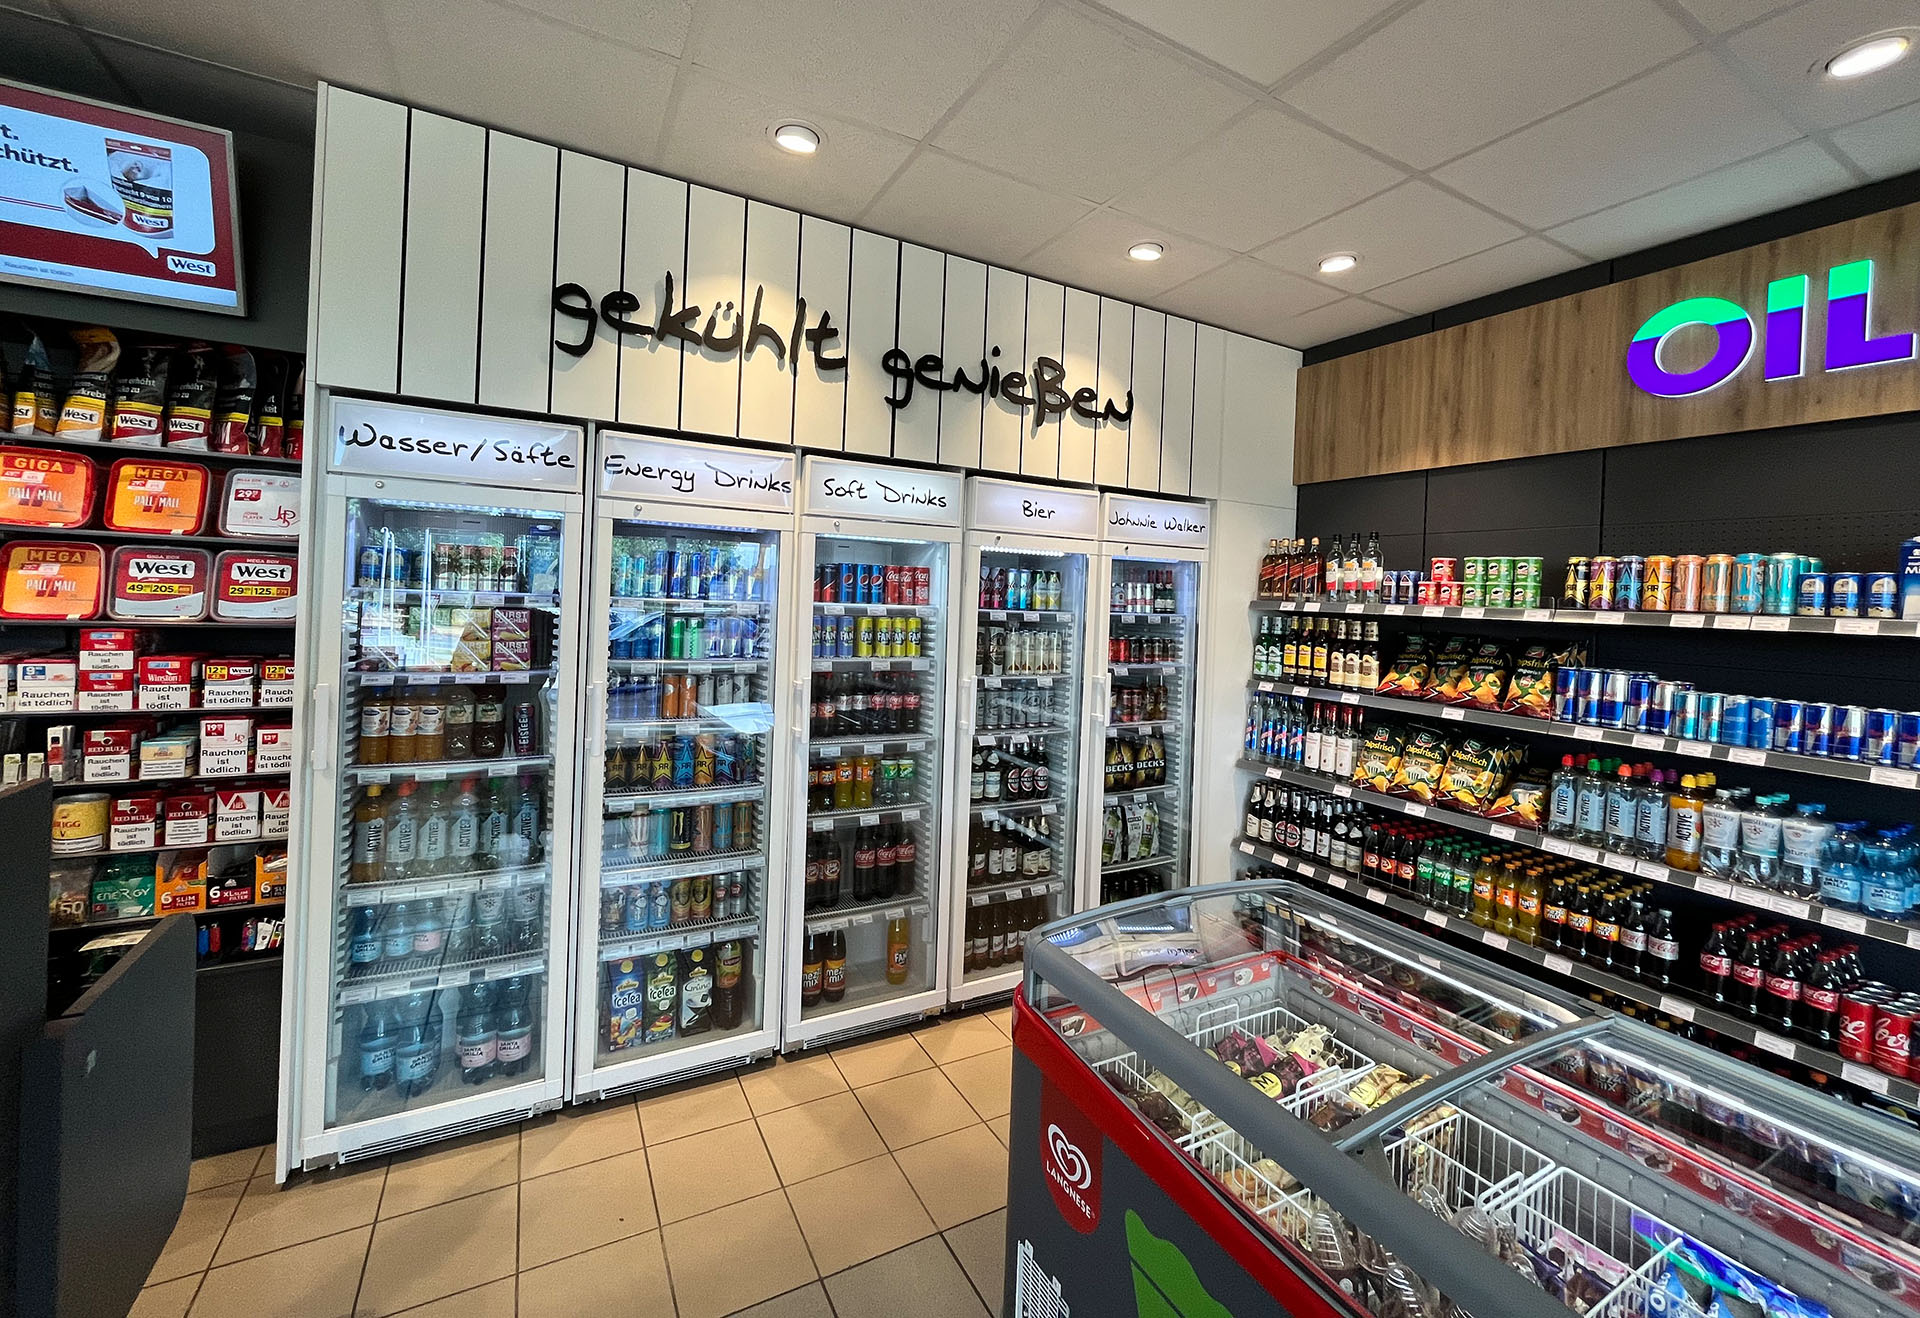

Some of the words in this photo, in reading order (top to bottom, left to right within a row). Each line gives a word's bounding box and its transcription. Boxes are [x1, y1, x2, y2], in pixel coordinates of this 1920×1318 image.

[134, 214, 165, 227] West
[171, 258, 212, 274] West
[1626, 259, 1918, 398] OIL
[554, 270, 847, 371] gekühlt
[882, 345, 1134, 427] genießen
[64, 408, 95, 422] West
[120, 414, 154, 428] West
[170, 419, 203, 432] West
[14, 458, 63, 472] GIGA
[135, 468, 186, 482] MEGA
[604, 455, 696, 492] Energy
[705, 462, 792, 494] Drinks
[8, 486, 30, 500] PALL
[38, 490, 62, 502] MALL
[823, 478, 868, 500] Soft
[875, 480, 948, 509] Drinks
[134, 494, 152, 508] PALL
[158, 495, 181, 508] MALL
[1022, 500, 1056, 521] Bier
[1108, 510, 1157, 530] Johnnie
[1164, 514, 1207, 534] Walker
[28, 550, 83, 563] MEGA
[135, 561, 189, 575] West
[236, 566, 287, 579] West
[26, 578, 47, 591] PALL
[53, 579, 77, 592] MALL
[128, 584, 144, 592] 49
[152, 584, 174, 593] 205
[254, 588, 272, 596] 125
[148, 674, 178, 682] Winston
[146, 702, 182, 710] tödlich
[1106, 763, 1134, 773] BECK'S
[1136, 759, 1165, 770] BECK'S
[1676, 812, 1692, 842] ACTIVE
[209, 886, 221, 898] 6
[260, 881, 271, 894] 6
[160, 891, 172, 904] 6
[1256, 1074, 1274, 1090] M
[1046, 1160, 1092, 1220] LANGNESE
